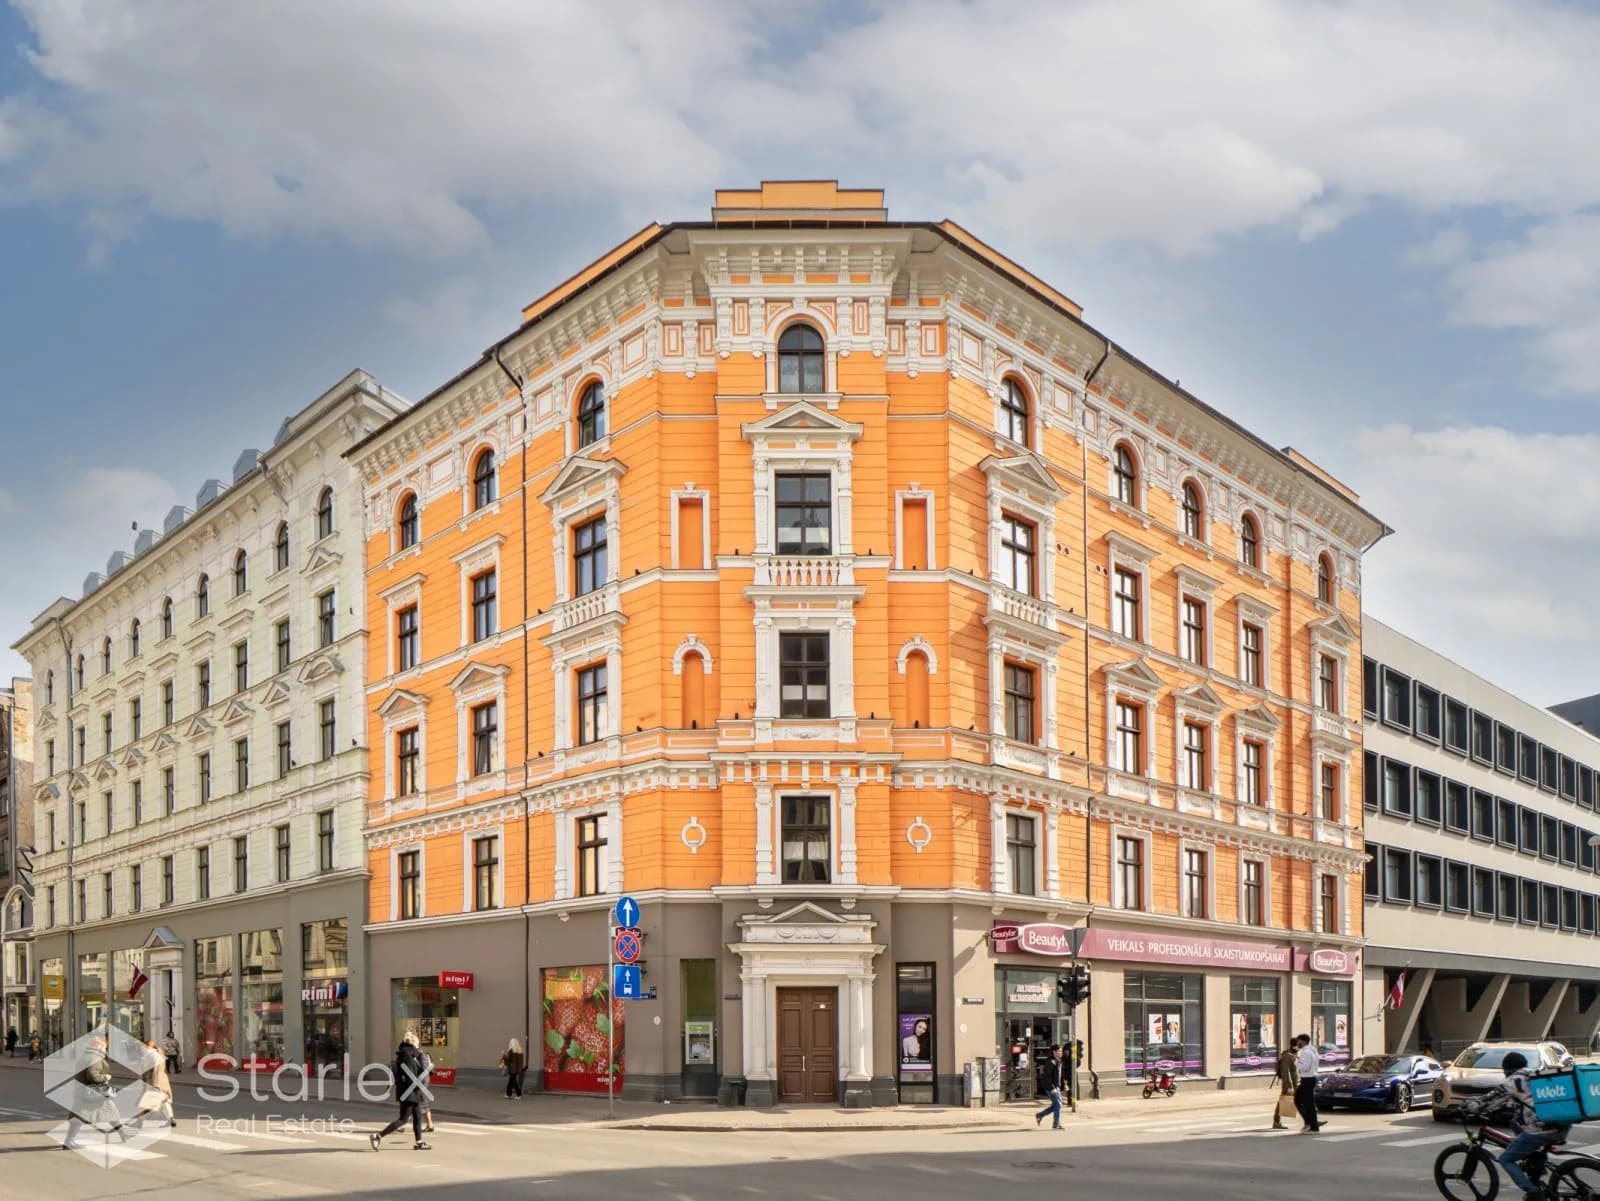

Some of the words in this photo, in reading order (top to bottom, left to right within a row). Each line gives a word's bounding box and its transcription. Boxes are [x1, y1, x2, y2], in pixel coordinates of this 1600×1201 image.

[1107, 939, 1145, 953] VEIKALS
[1148, 941, 1212, 958] PROFESIONĀLAI
[1535, 1085, 1567, 1099] Wolt
